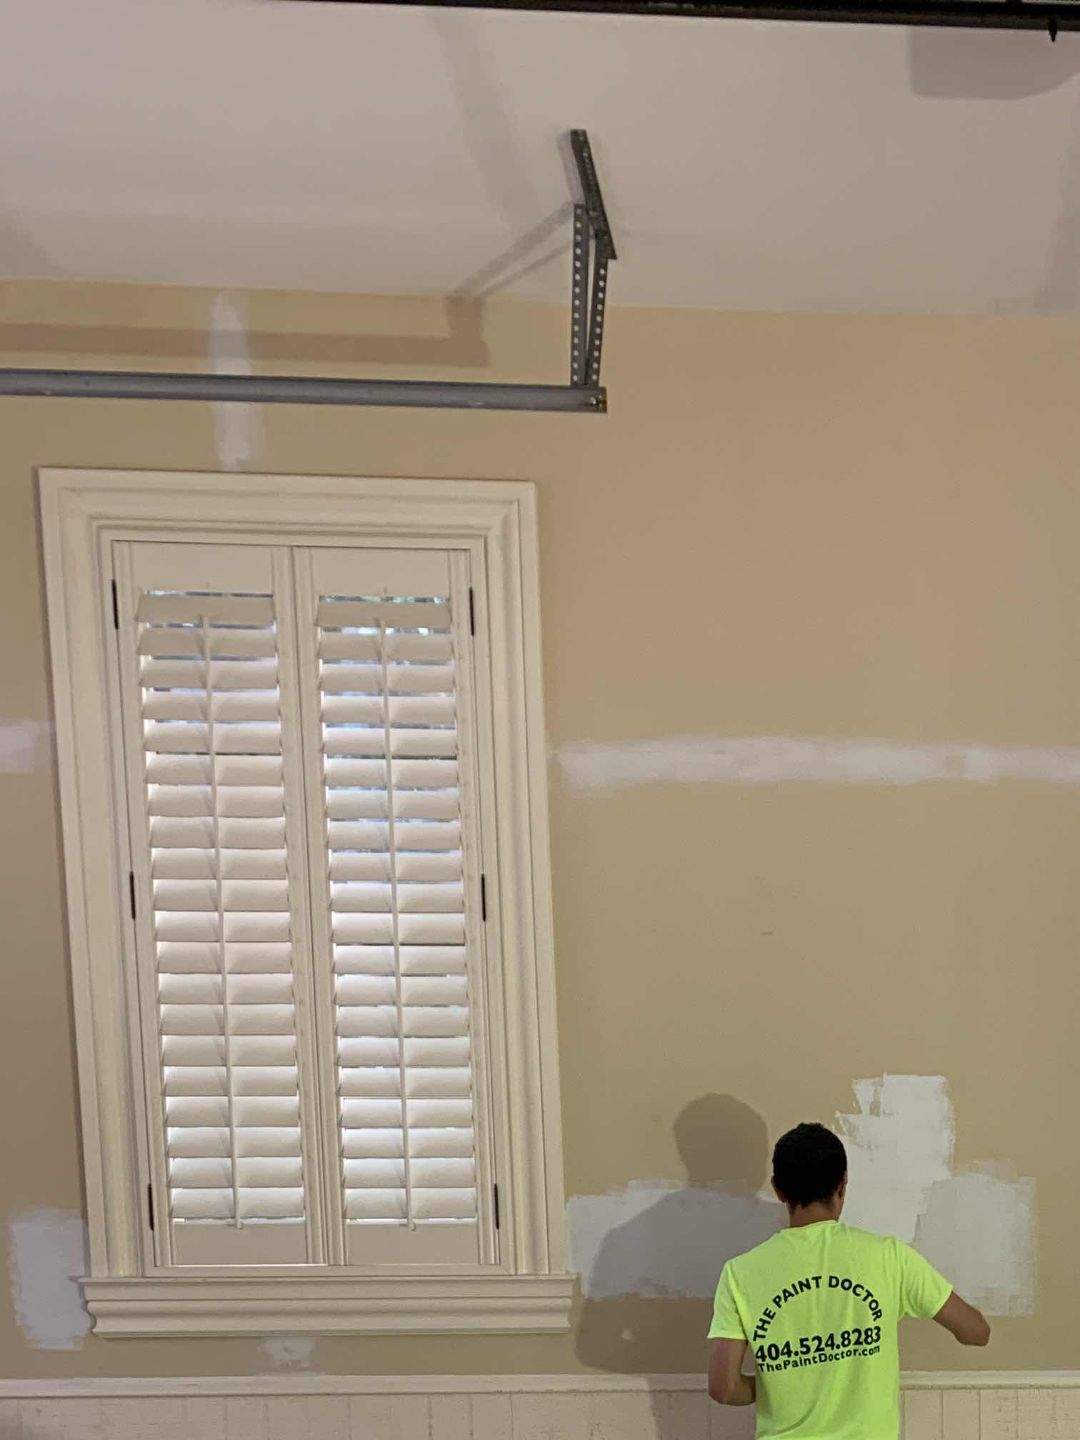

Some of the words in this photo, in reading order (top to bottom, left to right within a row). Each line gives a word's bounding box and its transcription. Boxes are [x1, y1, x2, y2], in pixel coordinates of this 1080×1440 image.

[753, 1307, 776, 1341] THE
[772, 1276, 822, 1309] PAINT
[828, 1275, 882, 1322] DOCTOR
[755, 1325, 881, 1362] 404.524.8283
[757, 1345, 880, 1372] ThePaintDoctor.com
